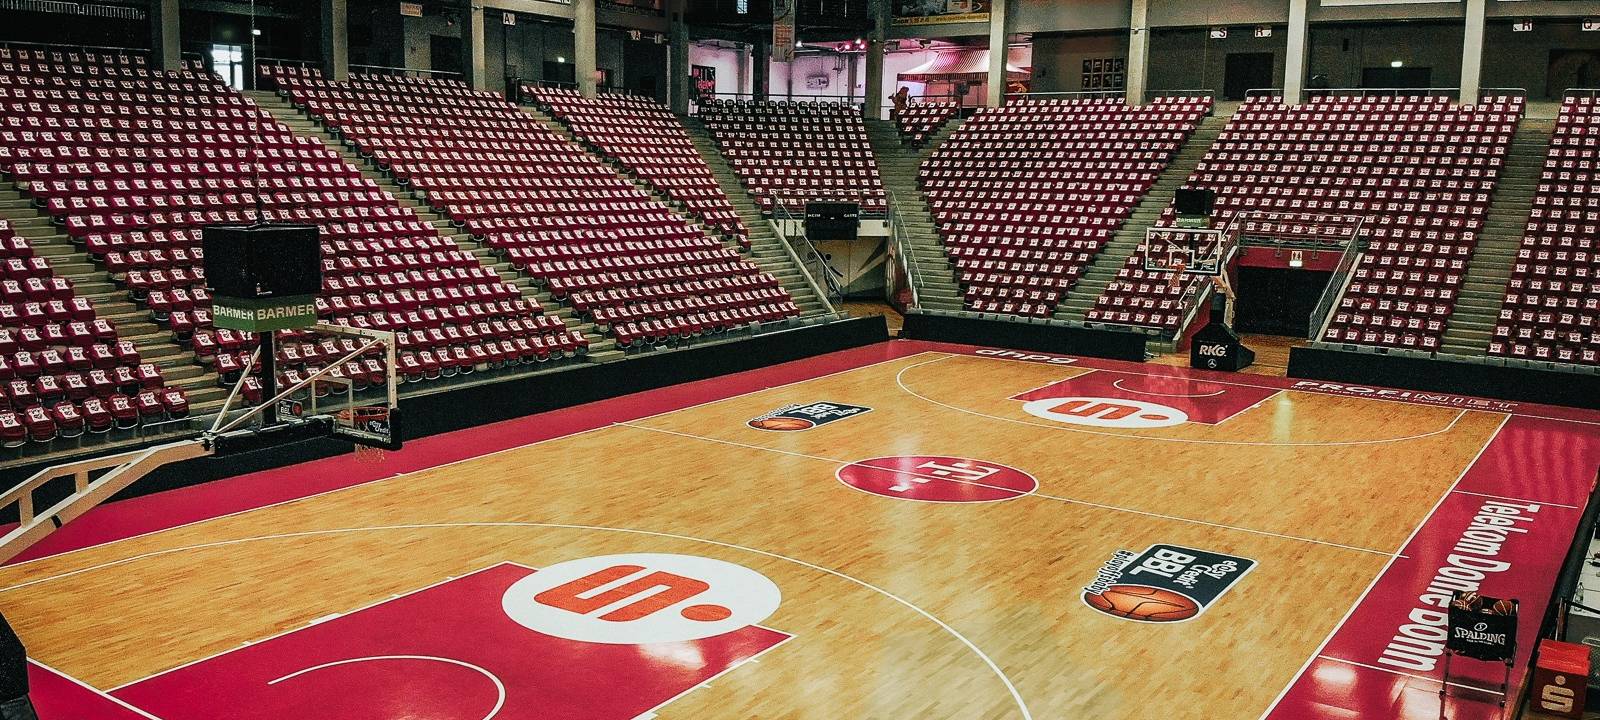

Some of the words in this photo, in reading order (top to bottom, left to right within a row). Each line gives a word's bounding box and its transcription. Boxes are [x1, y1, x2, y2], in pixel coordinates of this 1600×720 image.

[213, 304, 254, 320] BARMER
[257, 304, 315, 321] BARMER
[976, 349, 1078, 364] dhpg
[1199, 344, 1226, 357] RKG
[788, 403, 838, 416] BBL
[1453, 500, 1540, 556] Telekom
[1129, 548, 1197, 578] BBL
[1203, 560, 1238, 580] easy
[1173, 564, 1210, 587] Credit
[1454, 626, 1506, 645] SPALDING
